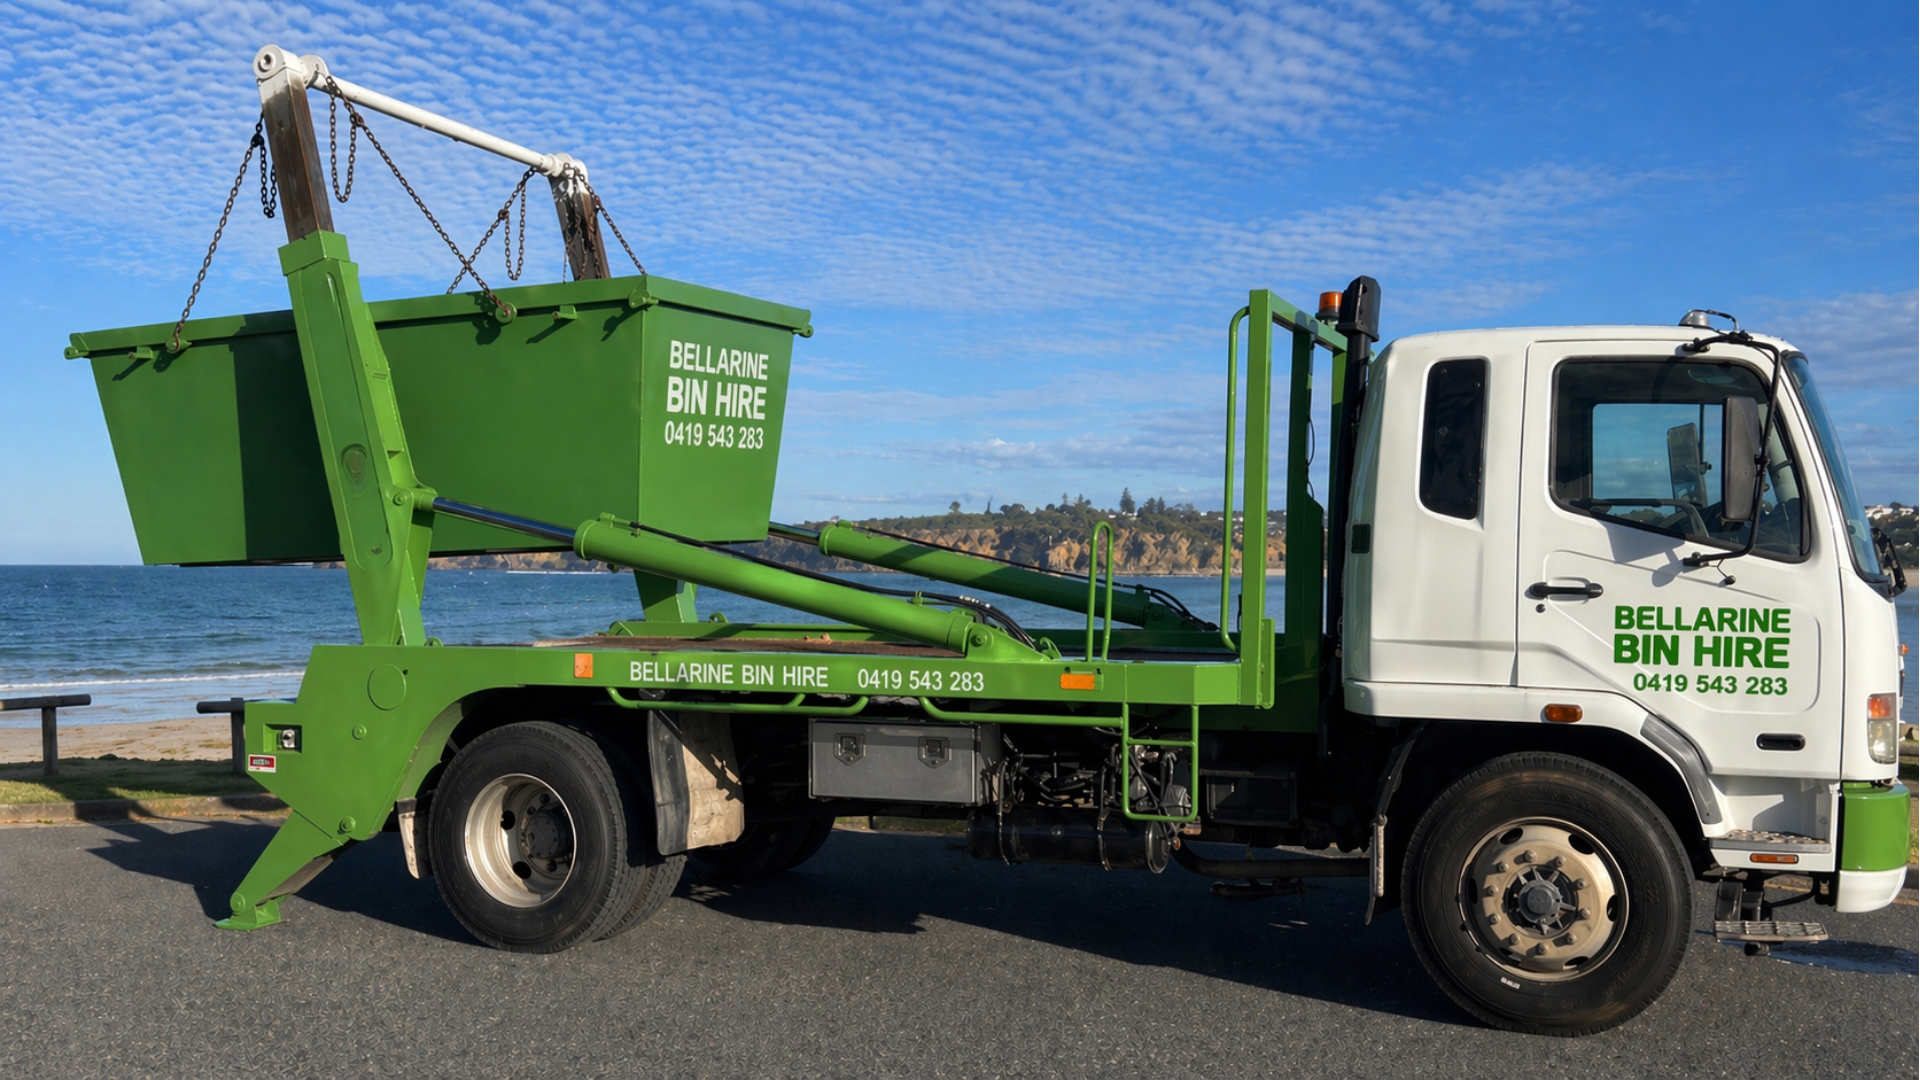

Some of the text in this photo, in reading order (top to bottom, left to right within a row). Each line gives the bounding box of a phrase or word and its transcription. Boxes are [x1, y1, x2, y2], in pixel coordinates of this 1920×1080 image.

[669, 340, 769, 381] BELLARINE
[666, 375, 767, 420] BIN HIRE
[664, 420, 764, 449] 0419 543 283
[1614, 605, 1791, 634] BELLARINE
[1613, 633, 1790, 669] BIN HIRE
[630, 661, 985, 692] BELLARINE BIN HIRE 0419 543 283
[1633, 673, 1788, 696] 0419 543 283
